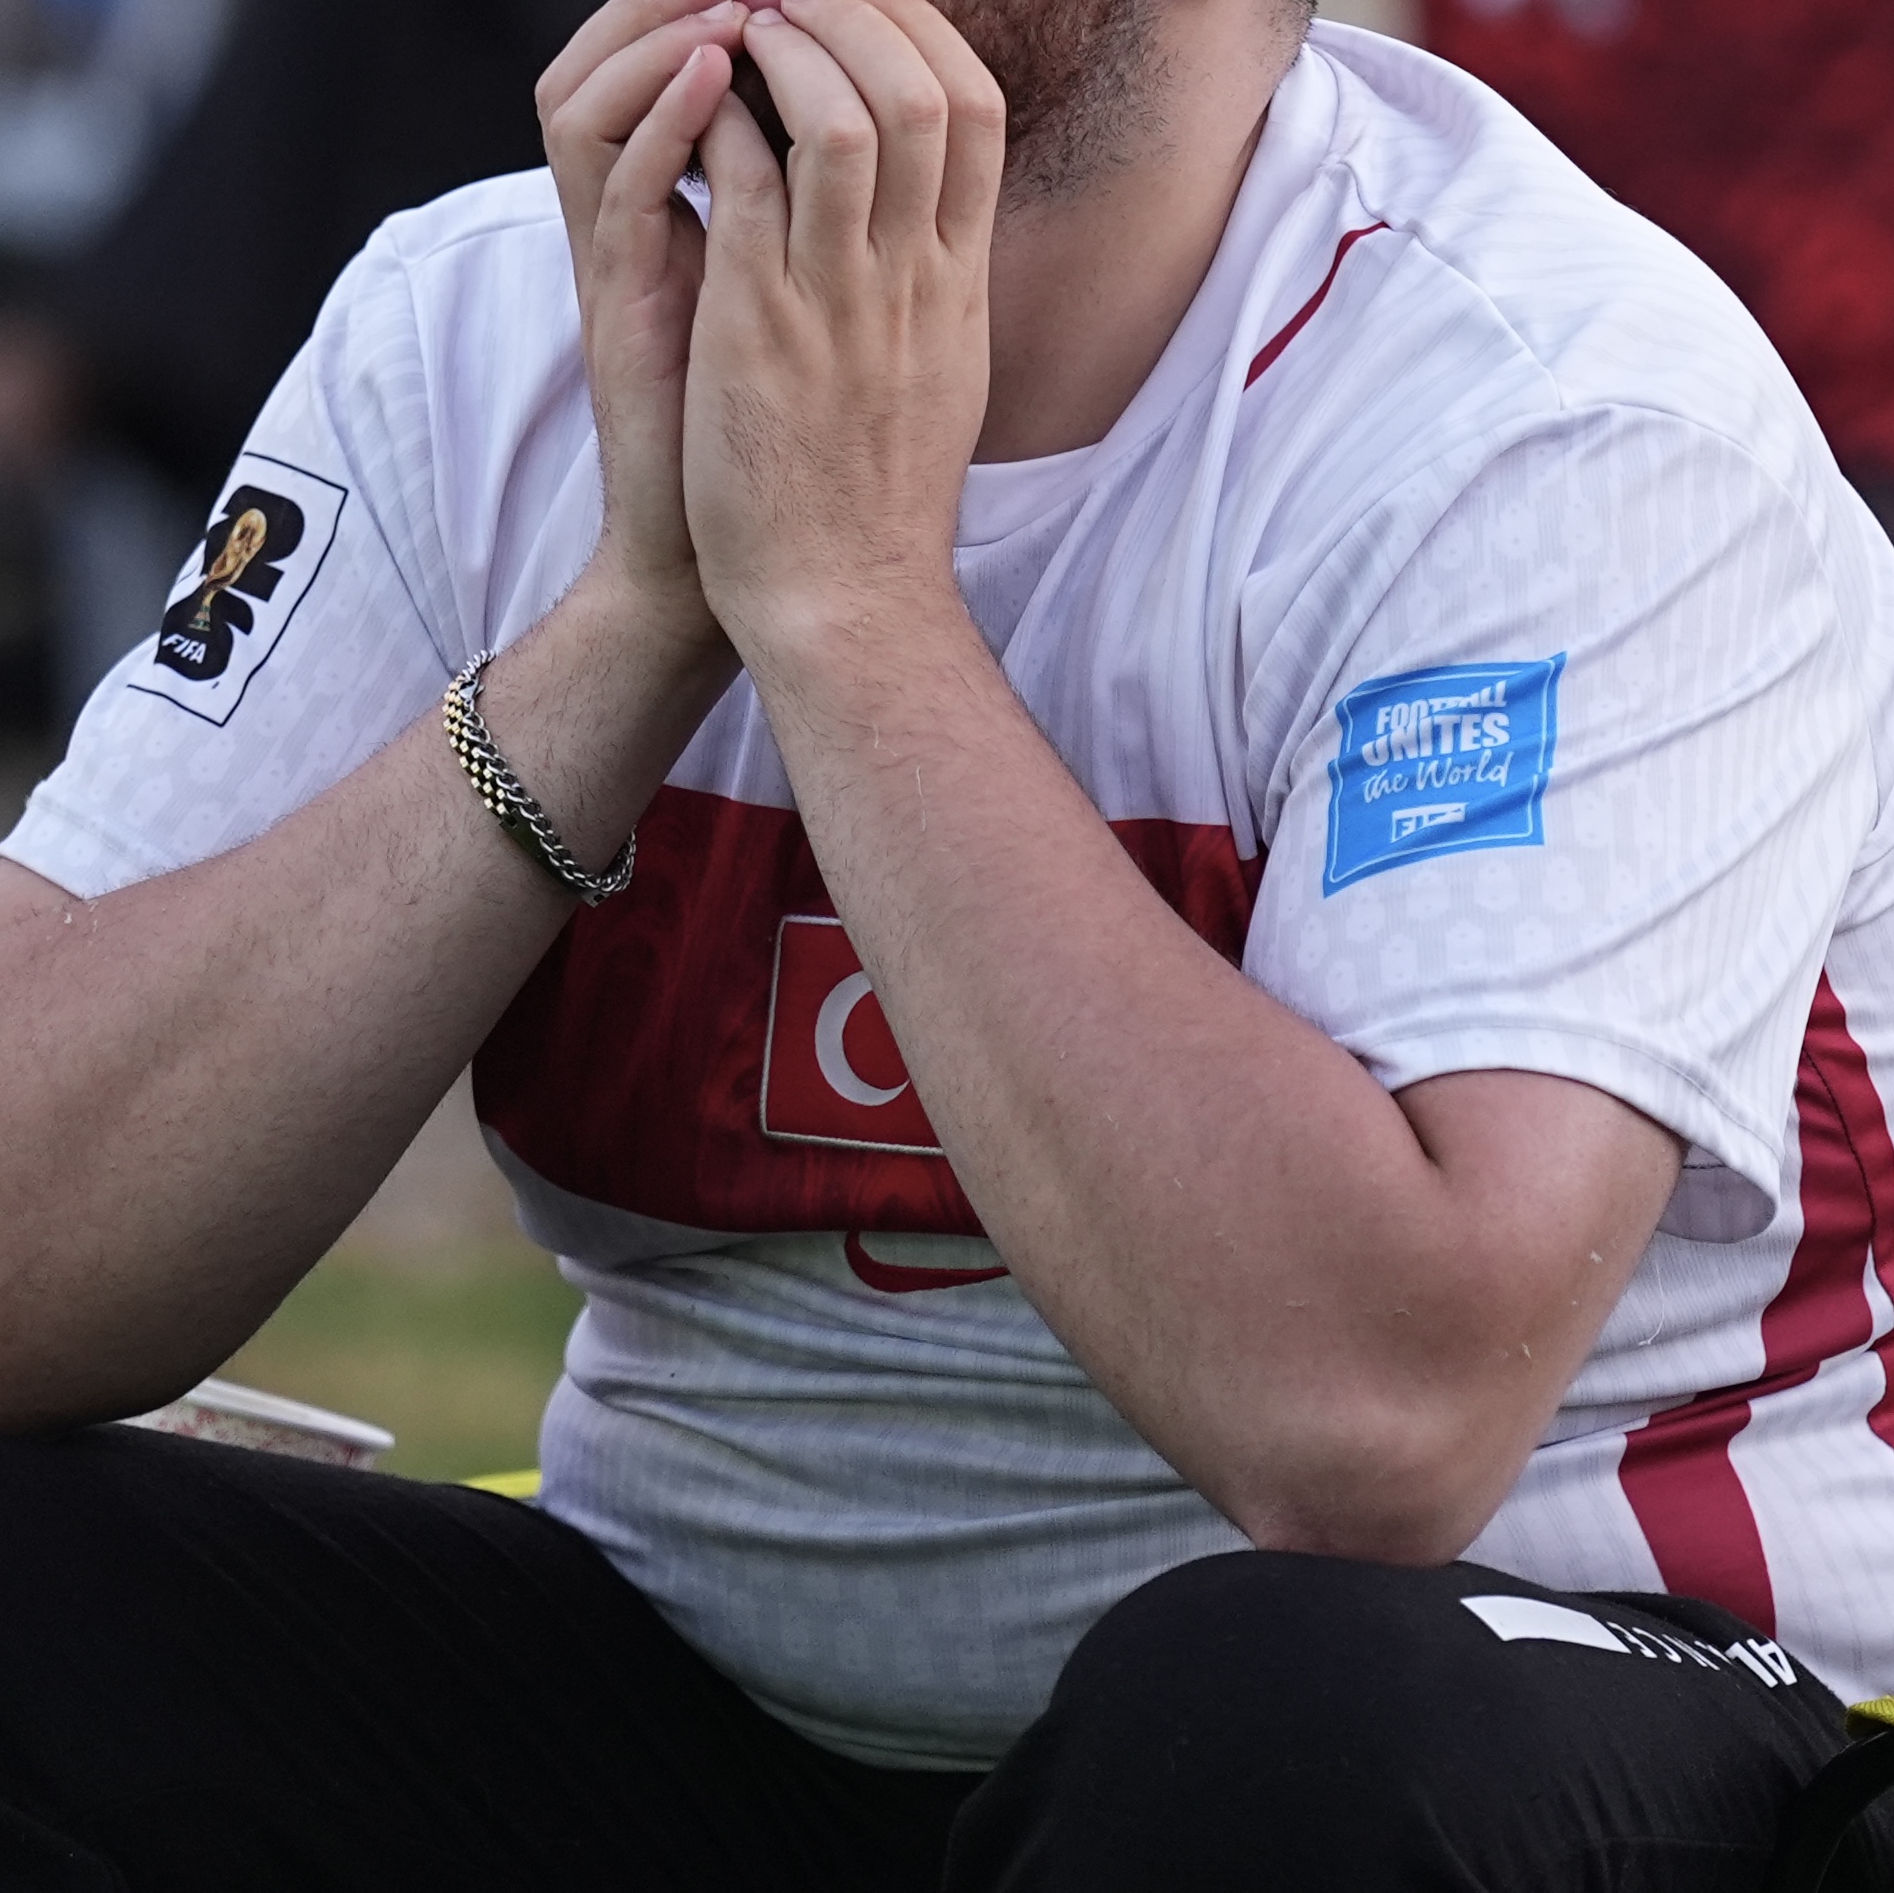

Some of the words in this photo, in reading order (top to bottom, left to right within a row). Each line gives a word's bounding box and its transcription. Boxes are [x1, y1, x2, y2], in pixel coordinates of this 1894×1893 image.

[161, 633, 207, 665] FIFA
[1362, 712, 1510, 766] UNITES
[1362, 769, 1409, 803] the
[1416, 749, 1514, 789] World
